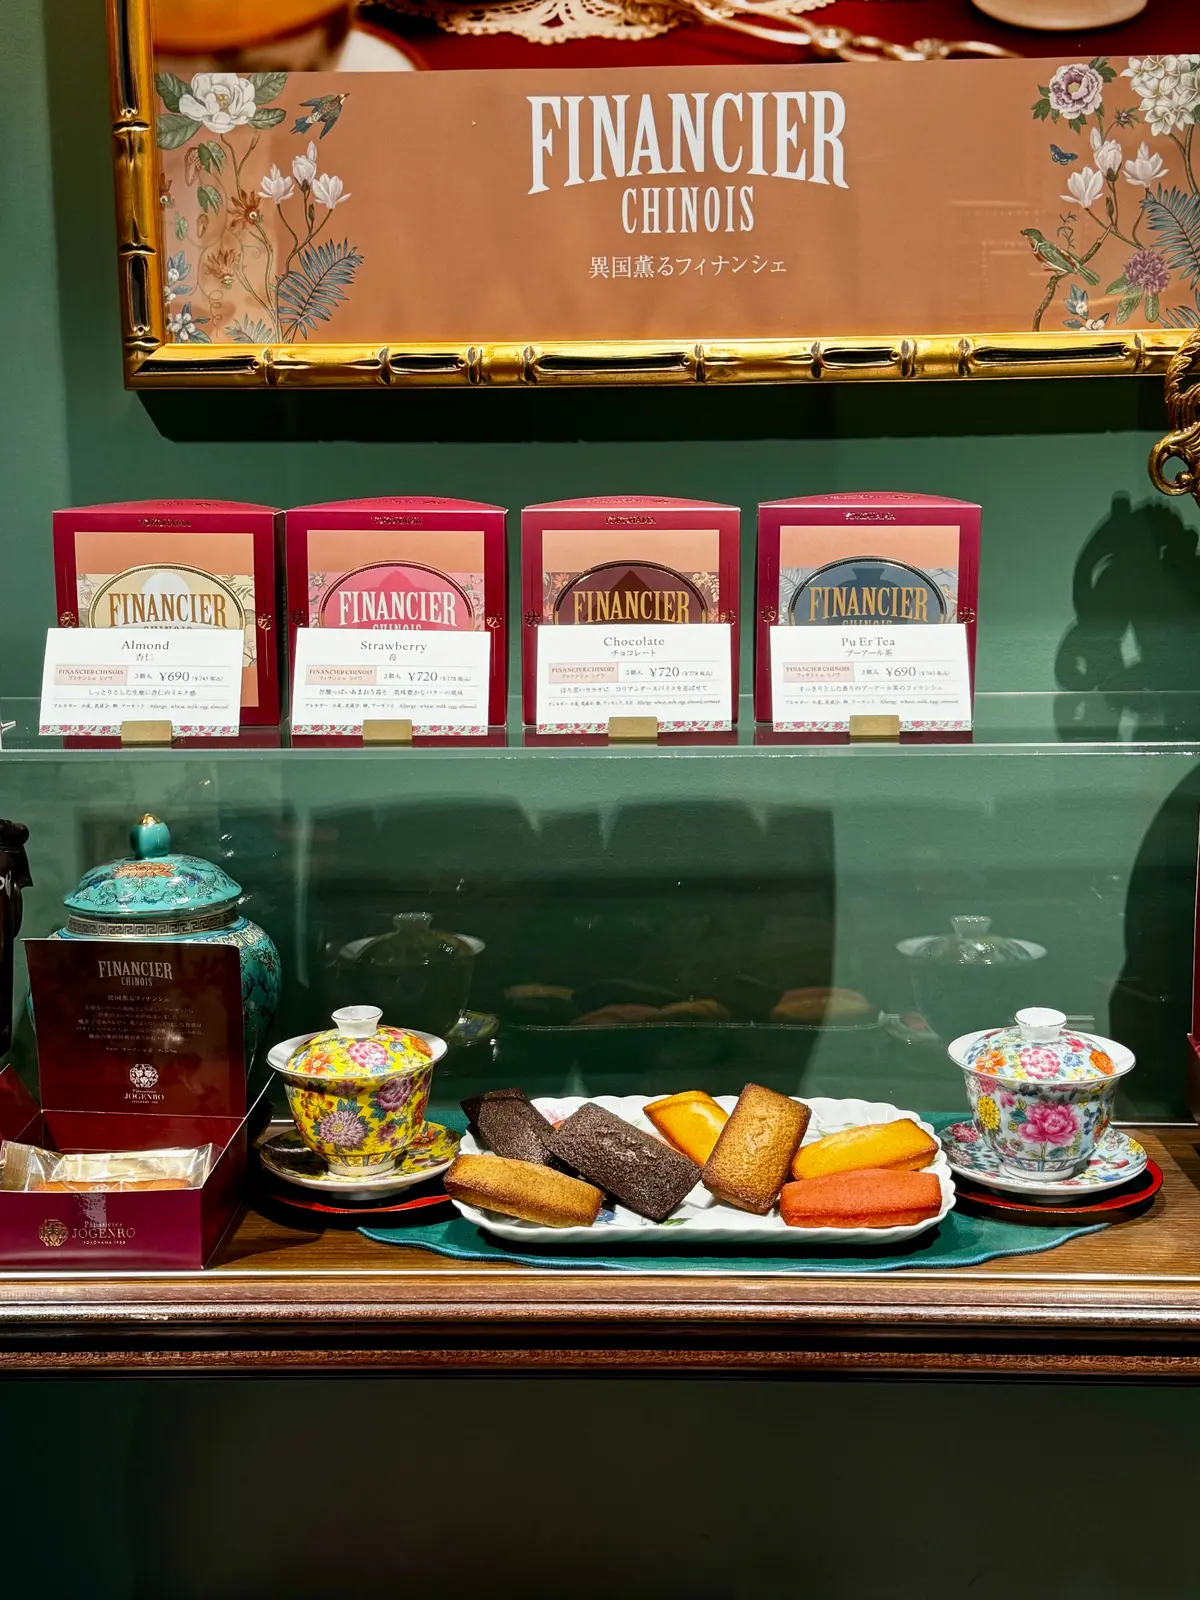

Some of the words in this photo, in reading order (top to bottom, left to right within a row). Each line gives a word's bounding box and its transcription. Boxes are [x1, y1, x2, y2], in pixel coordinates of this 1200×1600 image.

[526, 90, 849, 195] FINANCIER
[621, 185, 755, 234] CHINOIS
[589, 254, 787, 280] 異国薫るフィナンシェ
[338, 591, 457, 627] FINANCIER
[573, 590, 690, 625] FINANCIER
[808, 586, 929, 623] FINANCIER
[107, 593, 228, 629] FINANCIER
[121, 640, 170, 651] Almond
[360, 640, 427, 654] Strawberry
[603, 636, 665, 647] Chocolate
[841, 637, 856, 647] Pu
[859, 637, 873, 647] Er
[874, 636, 896, 647] Tea
[611, 648, 656, 658] チョコレート
[159, 671, 190, 682] ¥690
[408, 671, 438, 682] ¥720
[649, 666, 680, 677] ¥720
[885, 666, 917, 677] ¥690
[97, 960, 173, 981] FINANCIER
[121, 977, 153, 987] CHINOIS
[124, 1092, 165, 1101] JOGENRO
[71, 1227, 136, 1239] JOGENRO
